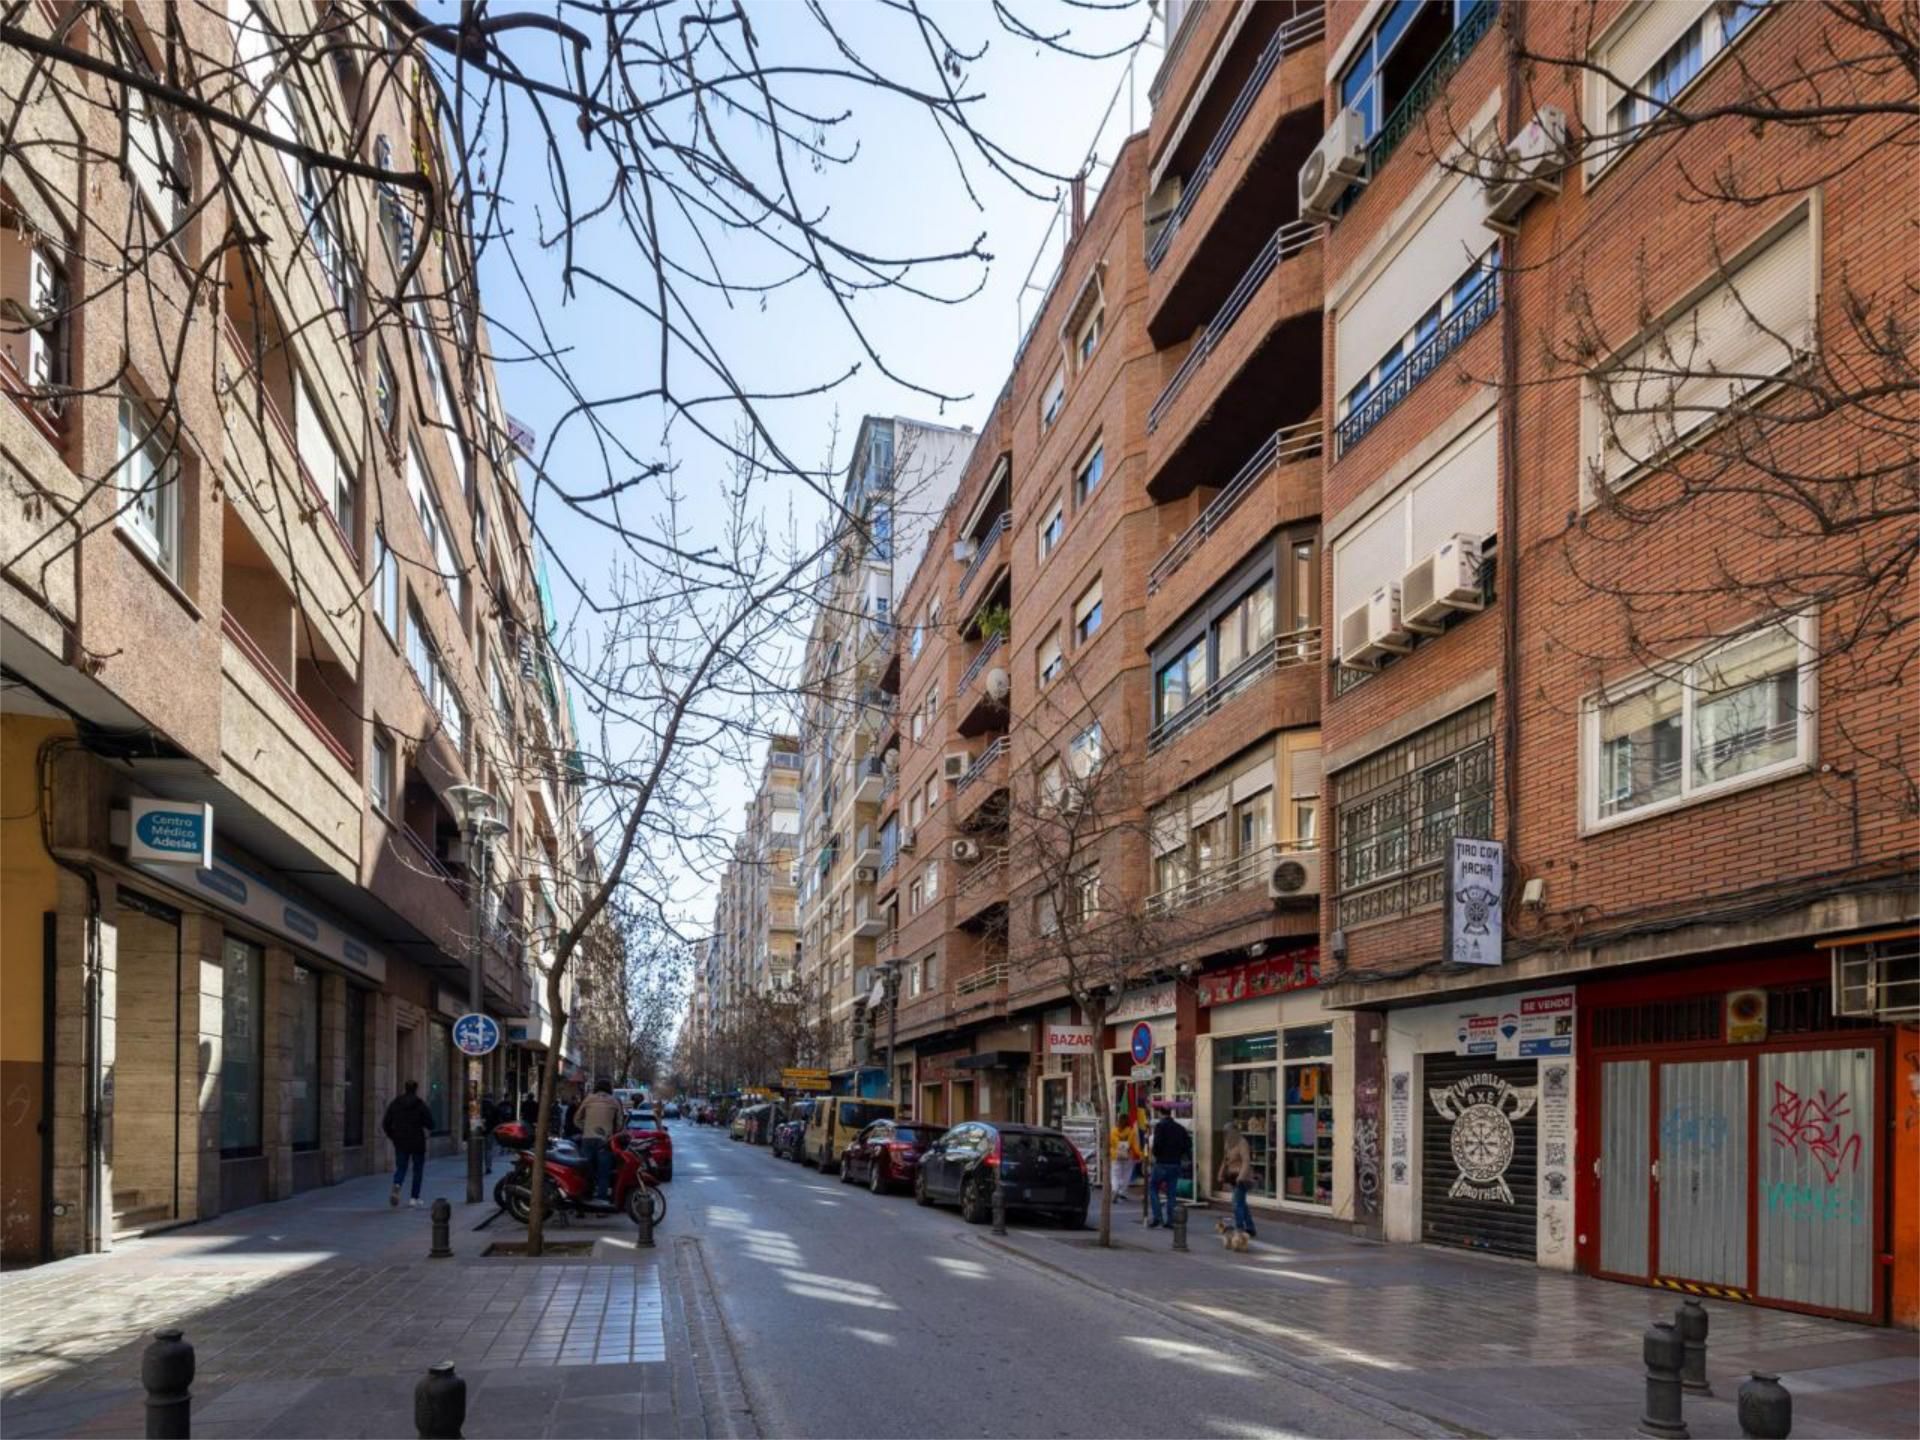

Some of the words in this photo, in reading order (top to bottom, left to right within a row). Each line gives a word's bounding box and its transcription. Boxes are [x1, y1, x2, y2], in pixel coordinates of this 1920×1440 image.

[151, 815, 193, 827] Centro
[151, 825, 196, 838] Médico
[1456, 843, 1477, 860] TIRO
[1479, 846, 1500, 864] CON
[1462, 861, 1493, 881] HACHA
[1523, 1001, 1535, 1012] SE
[1537, 997, 1570, 1010] VENDE
[1050, 1034, 1093, 1046] BAZAR
[1454, 1073, 1506, 1097] VALHALLA
[1467, 1092, 1496, 1105] AXE
[1455, 1182, 1508, 1203] BROTHER
